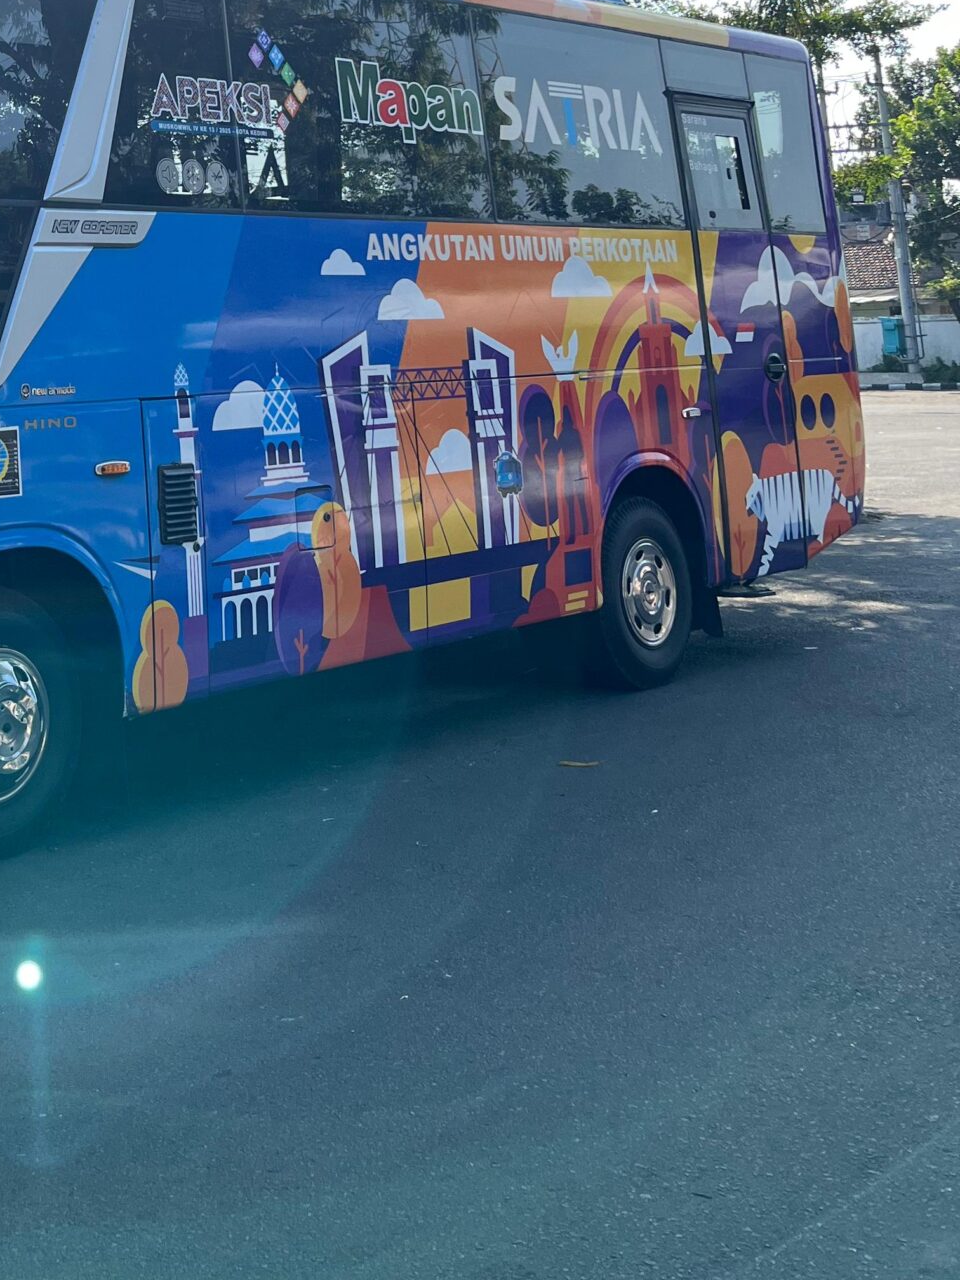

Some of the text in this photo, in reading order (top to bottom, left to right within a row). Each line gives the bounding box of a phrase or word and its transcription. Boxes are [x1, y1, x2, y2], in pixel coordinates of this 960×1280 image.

[151, 72, 272, 124] APEKSI
[335, 57, 484, 144] Mapan
[494, 76, 663, 157] SATRIA
[52, 219, 138, 234] NEW COASTER
[366, 233, 678, 263] ANGKUTAN UMUM PERKOTAAN
[32, 383, 76, 396] new armada
[24, 416, 77, 431] HINO
